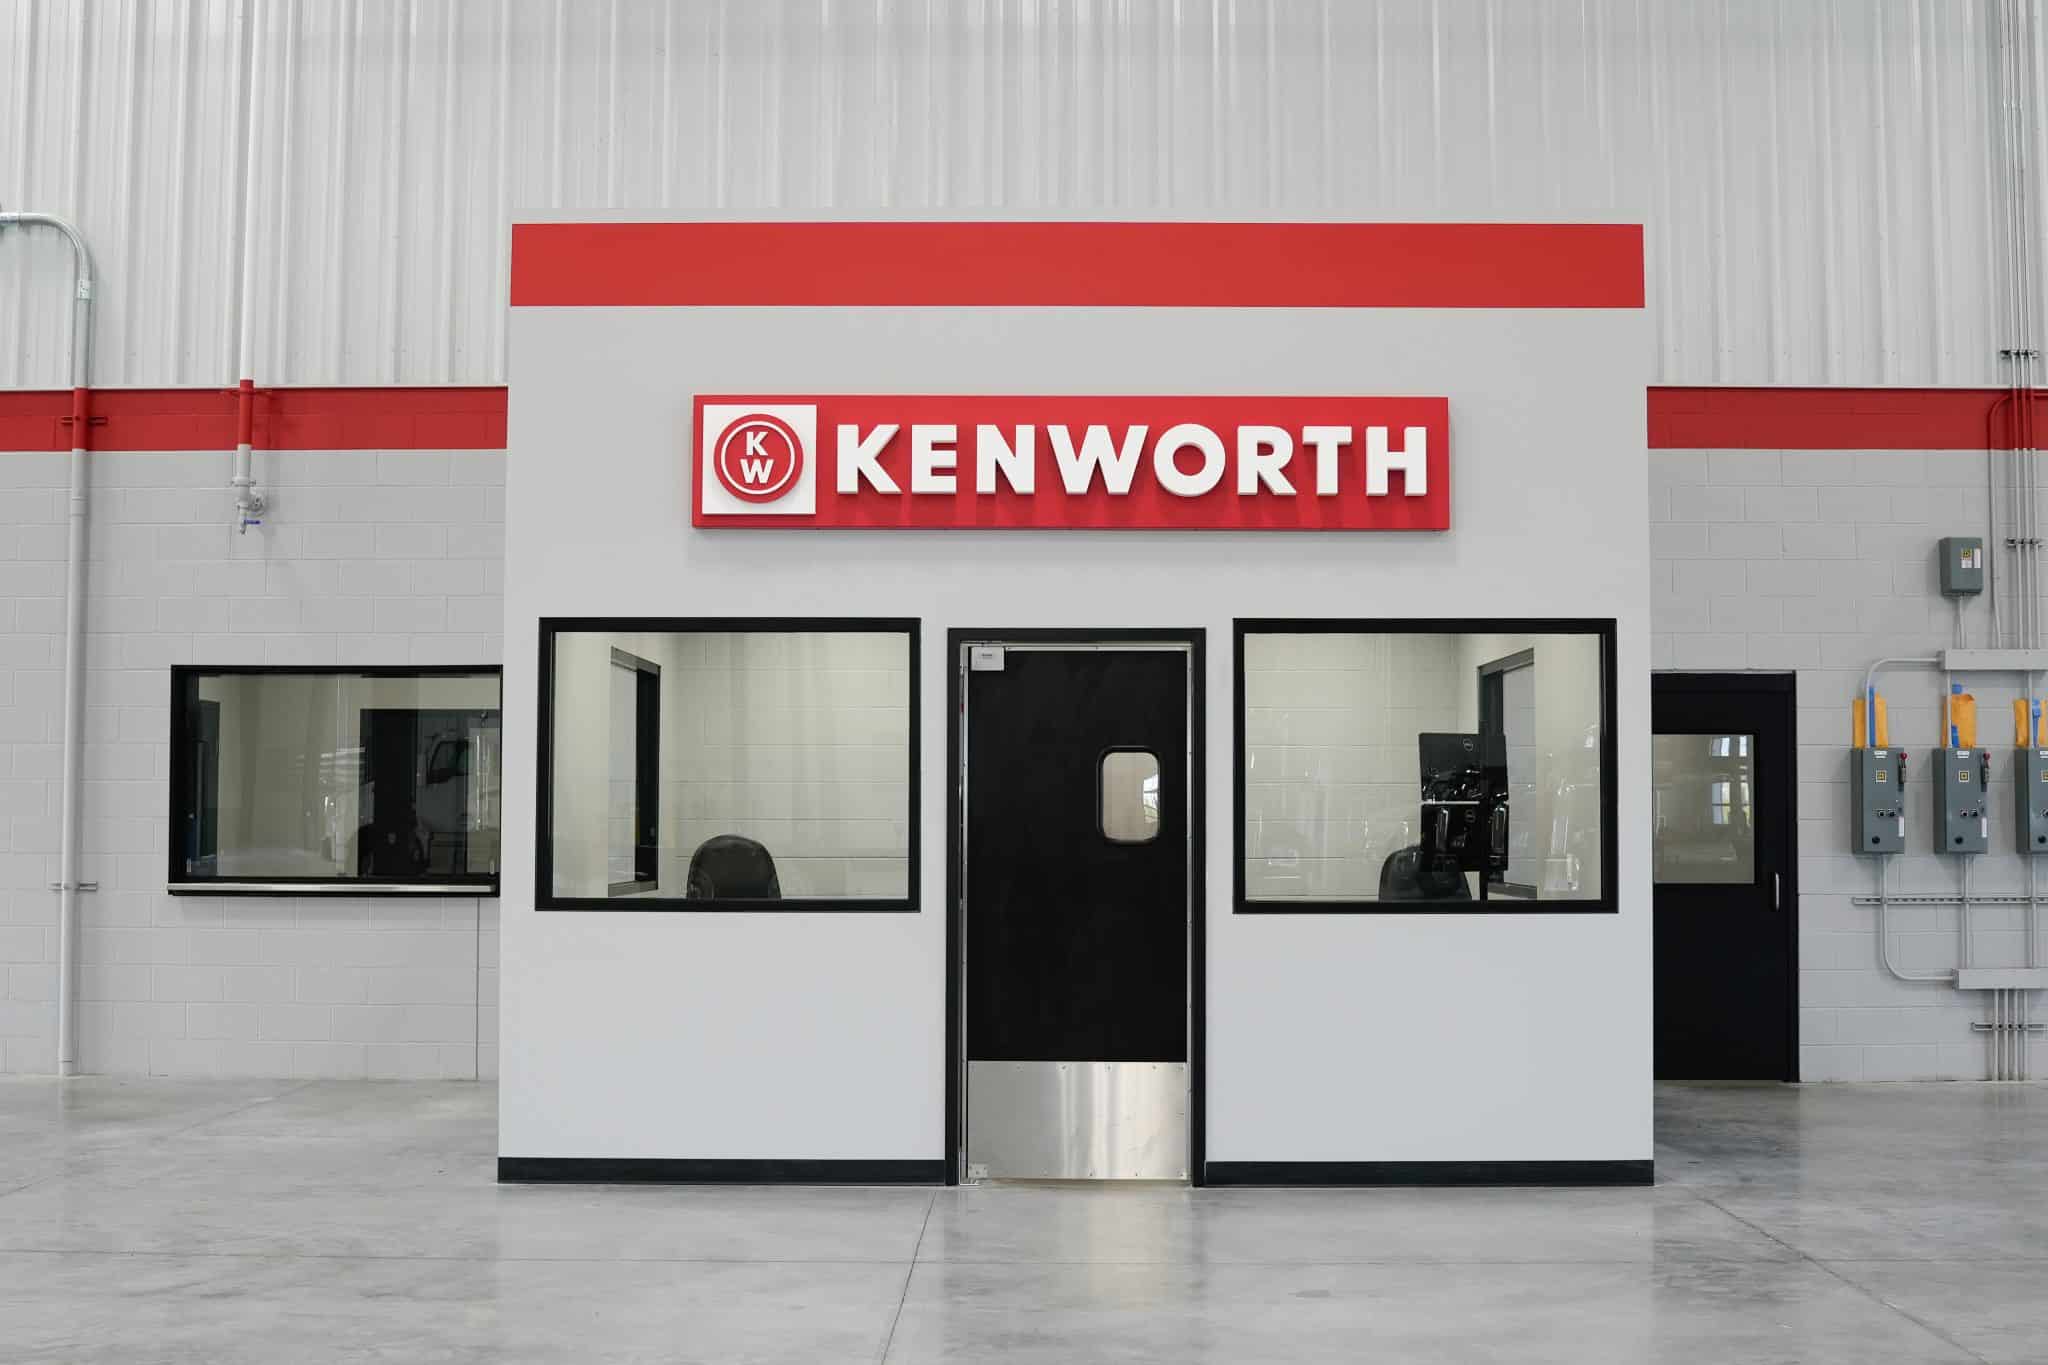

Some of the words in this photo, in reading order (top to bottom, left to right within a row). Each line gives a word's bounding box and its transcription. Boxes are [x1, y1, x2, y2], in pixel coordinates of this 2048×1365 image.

[746, 431, 769, 456] K
[740, 458, 775, 484] W
[836, 423, 1427, 496] KENWORTH
